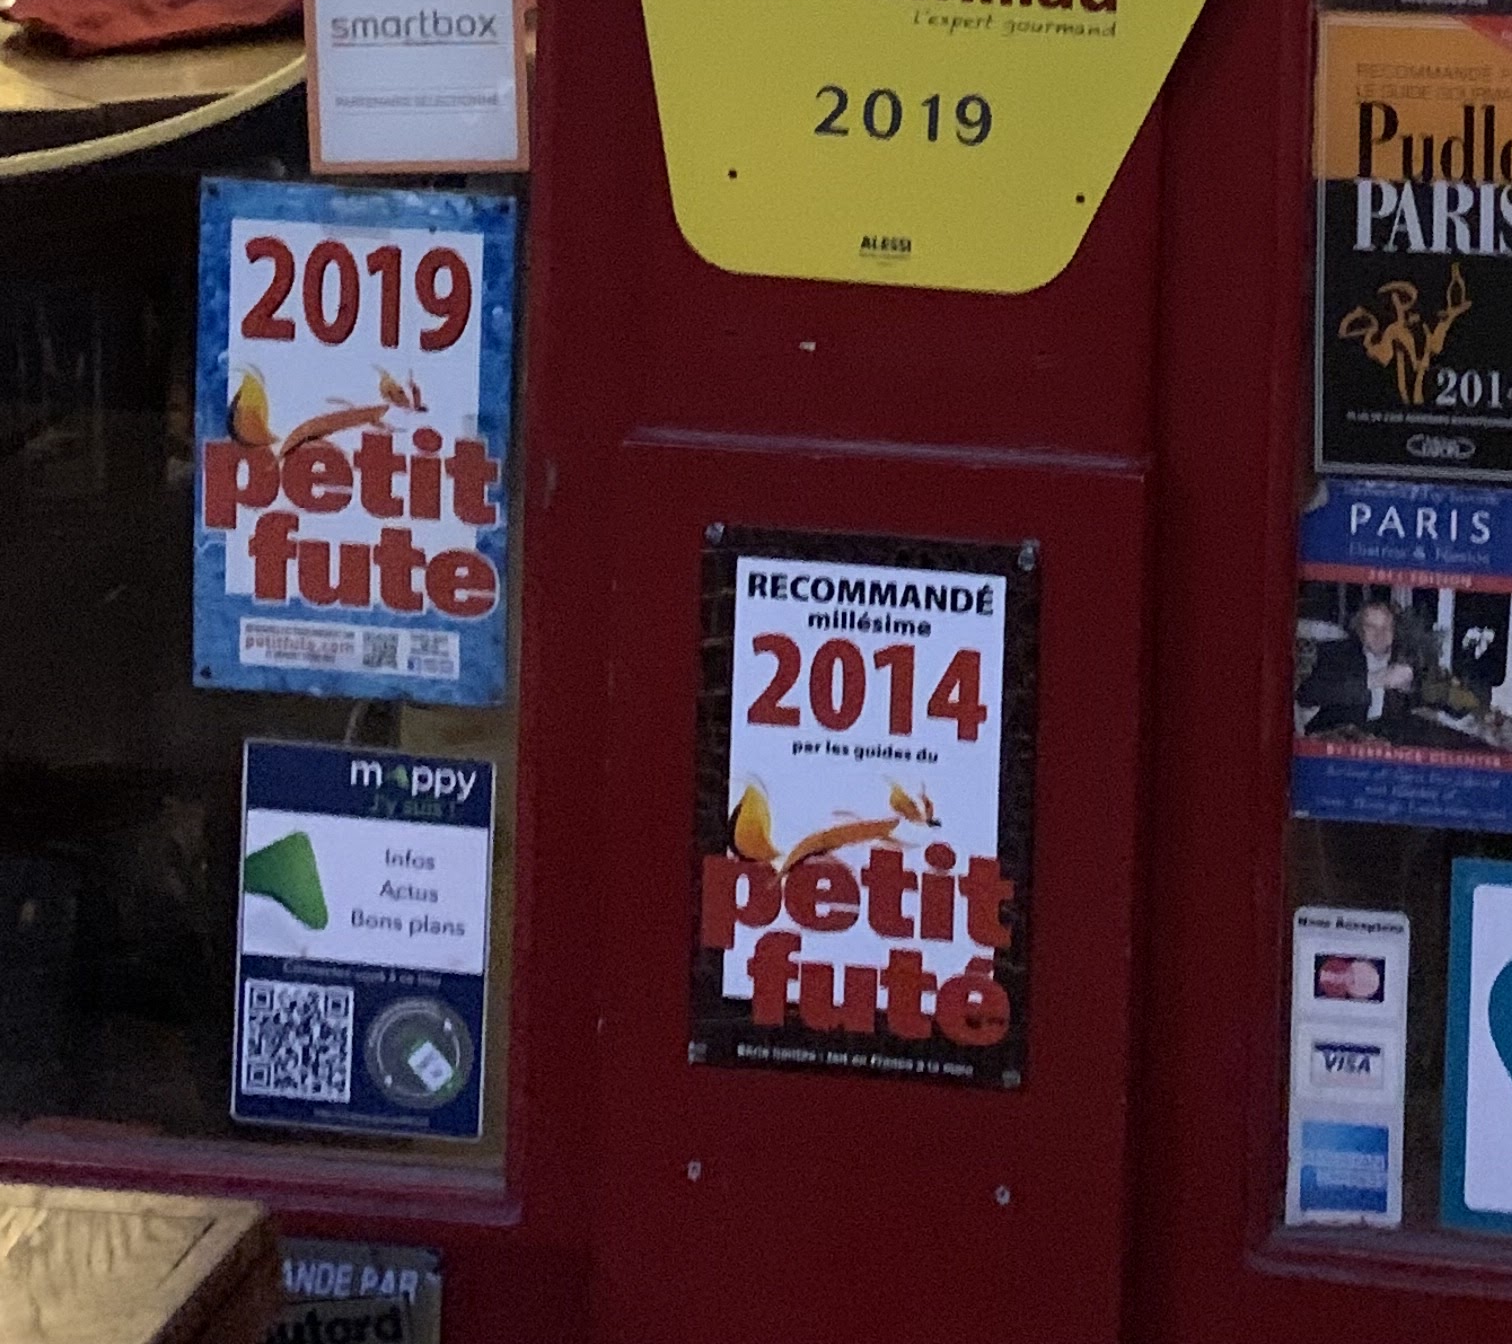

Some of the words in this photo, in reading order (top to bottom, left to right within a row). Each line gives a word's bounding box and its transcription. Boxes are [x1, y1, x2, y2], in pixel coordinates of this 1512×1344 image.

[331, 8, 498, 40] smartbox
[1000, 13, 1117, 39] gourmand
[813, 84, 994, 147] 2019
[240, 234, 473, 353] 2019
[202, 426, 501, 530] petit
[1350, 502, 1491, 545] PARIS
[746, 571, 995, 616] RECOMMANDÉ
[807, 610, 932, 638] millésime
[746, 631, 988, 742] 2014
[916, 747, 939, 764] du
[384, 848, 435, 871] Infos
[378, 879, 439, 904] Actus
[702, 841, 1015, 949] petit
[350, 908, 403, 930] Bons
[408, 914, 466, 938] plans
[746, 929, 1012, 1046] futé
[1323, 1053, 1372, 1075] VISA
